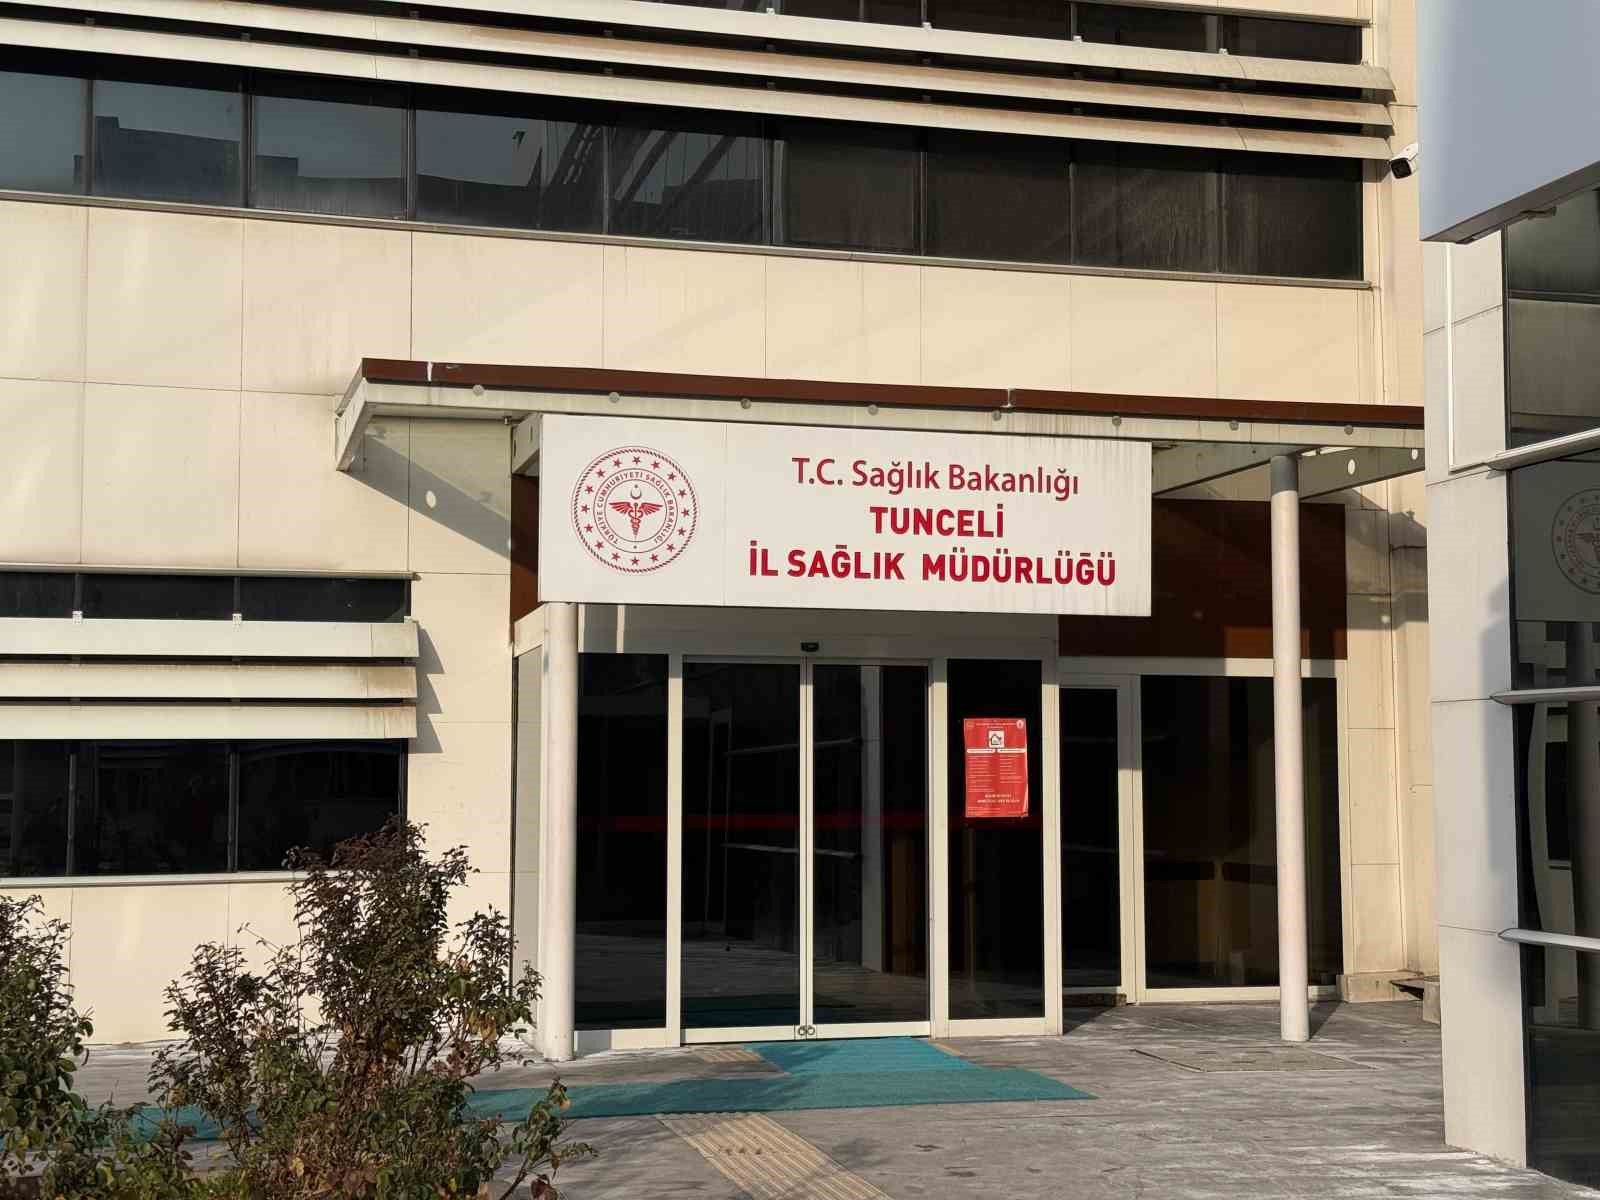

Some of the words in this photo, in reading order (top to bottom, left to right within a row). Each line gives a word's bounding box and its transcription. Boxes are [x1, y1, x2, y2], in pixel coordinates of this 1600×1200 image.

[791, 457, 844, 486] T.C.
[851, 460, 940, 496] Sağlık
[949, 464, 1079, 501] Bakanlığı
[869, 504, 1004, 539] TUNCELİ
[748, 540, 779, 577] İL
[786, 544, 906, 582] SAĞLIK
[921, 546, 1117, 587] MÜDÜRLÜĞÜ
